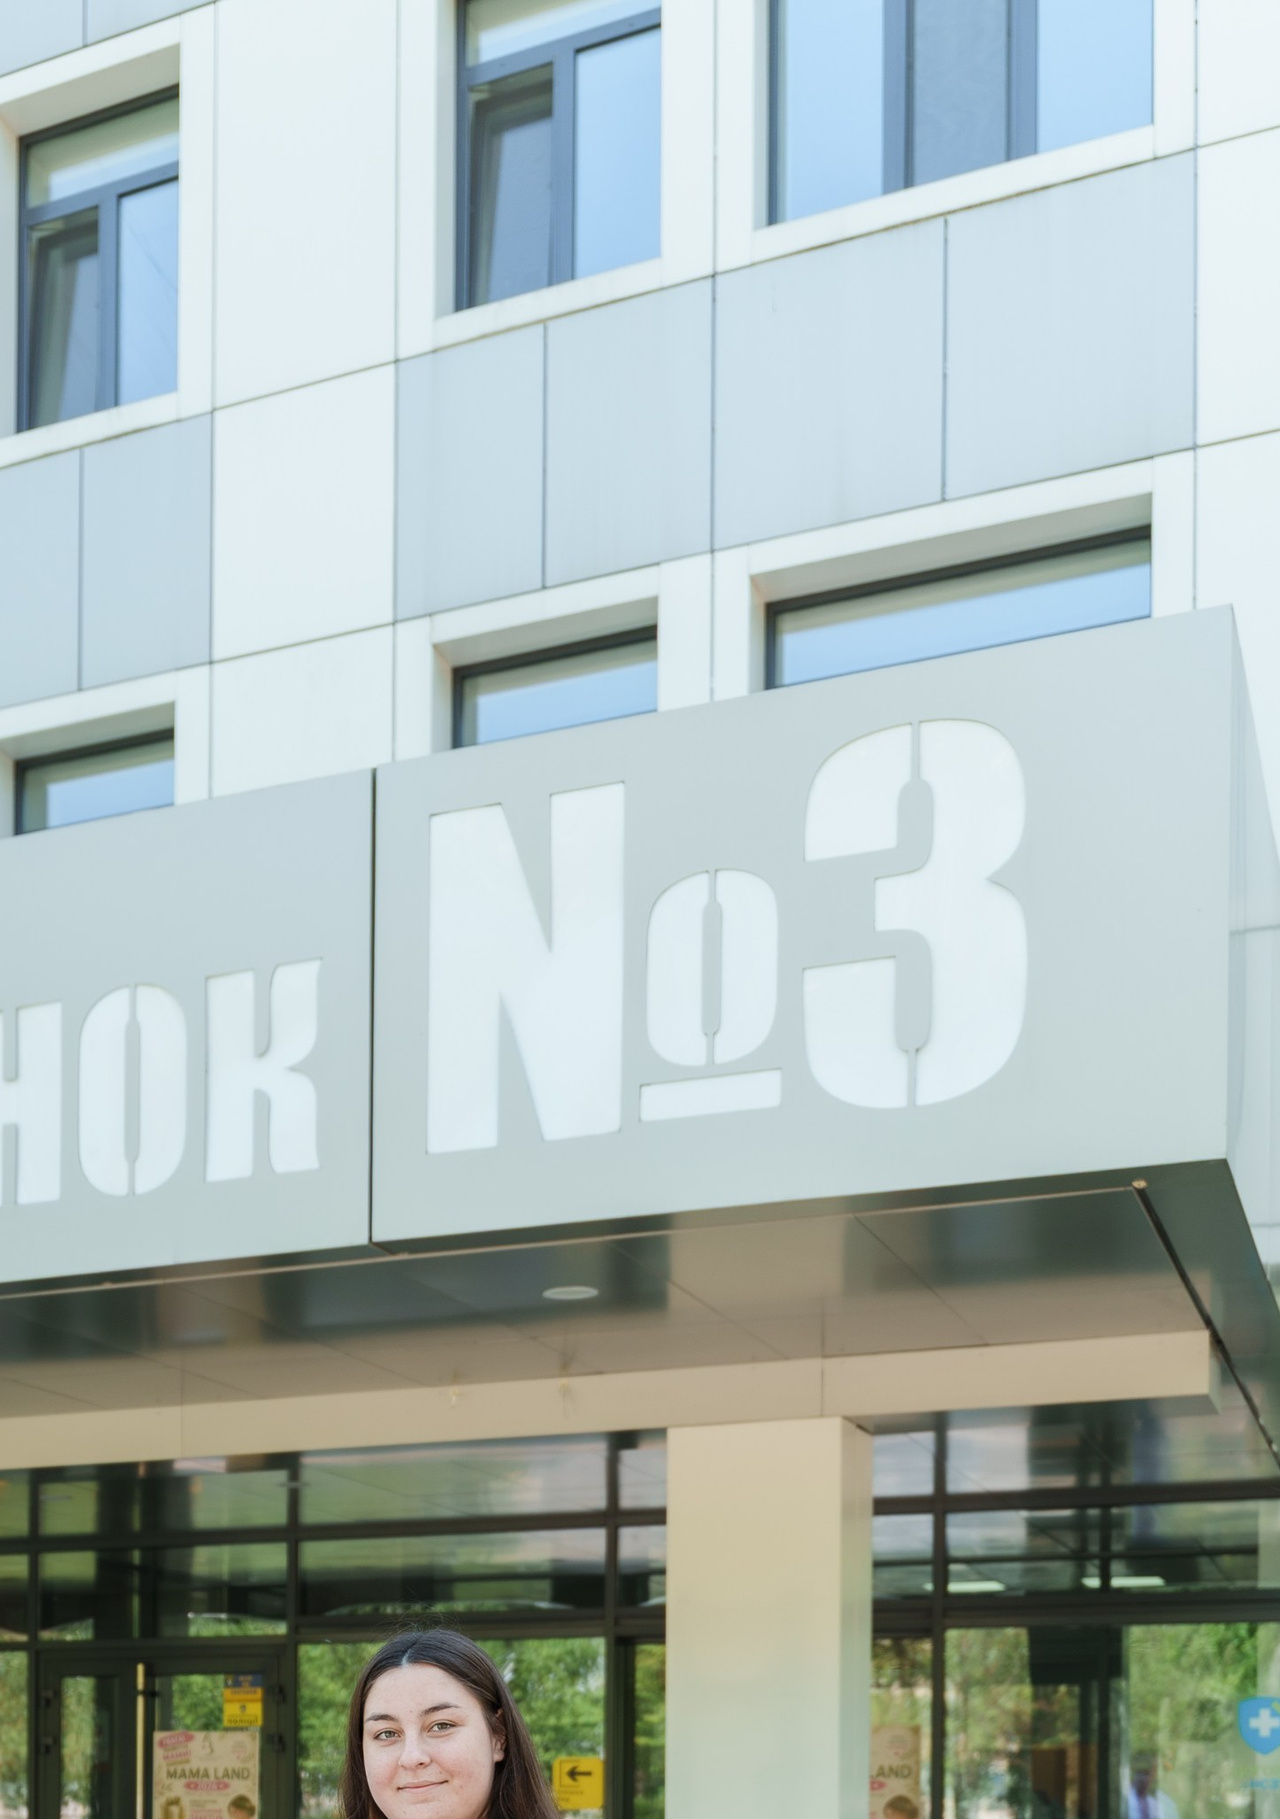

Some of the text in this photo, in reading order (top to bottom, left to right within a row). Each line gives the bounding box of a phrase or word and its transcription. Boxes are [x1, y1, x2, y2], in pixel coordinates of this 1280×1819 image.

[166, 1766, 250, 1780] MAMA LAND
[870, 1763, 913, 1779] AND
